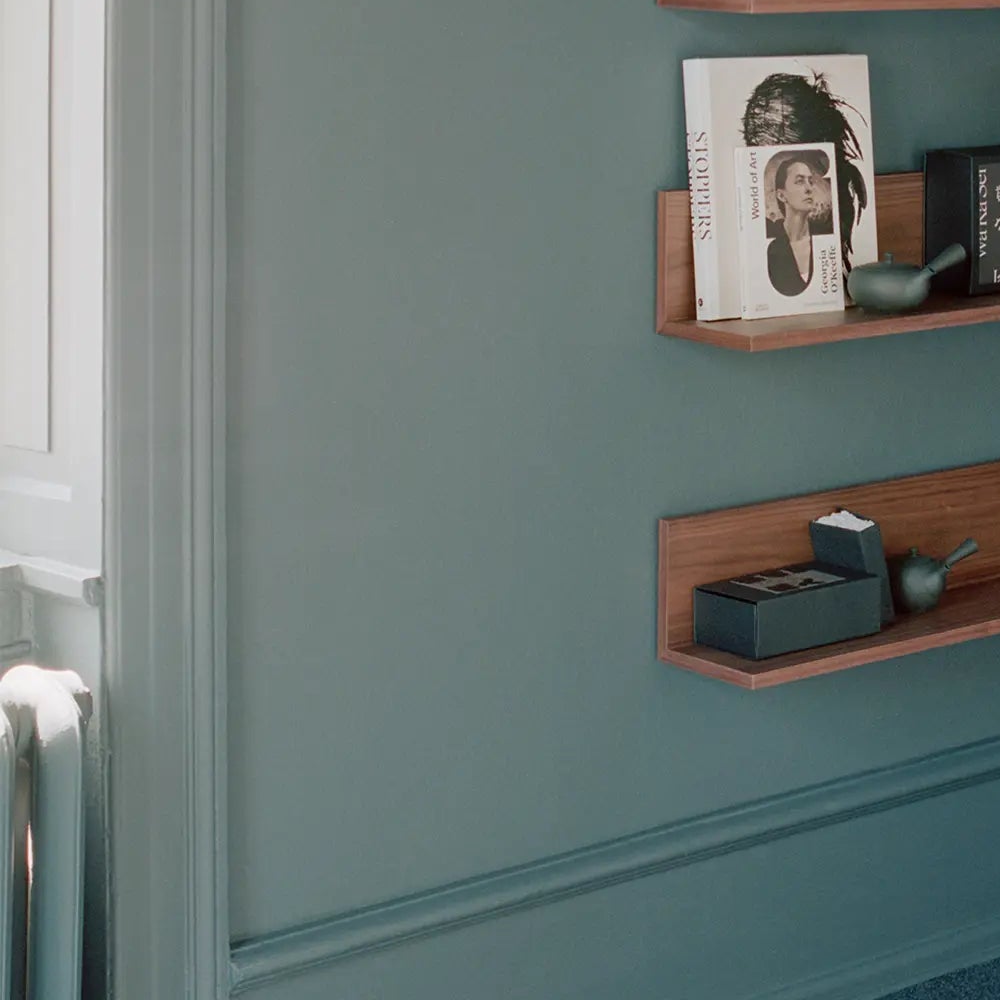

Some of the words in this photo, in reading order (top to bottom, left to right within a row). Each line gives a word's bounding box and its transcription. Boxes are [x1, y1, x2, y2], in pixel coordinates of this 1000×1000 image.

[749, 151, 758, 170] Art
[694, 131, 712, 241] STOPPERS
[750, 172, 758, 184] of
[751, 186, 760, 220] World
[819, 249, 829, 295] Georgia
